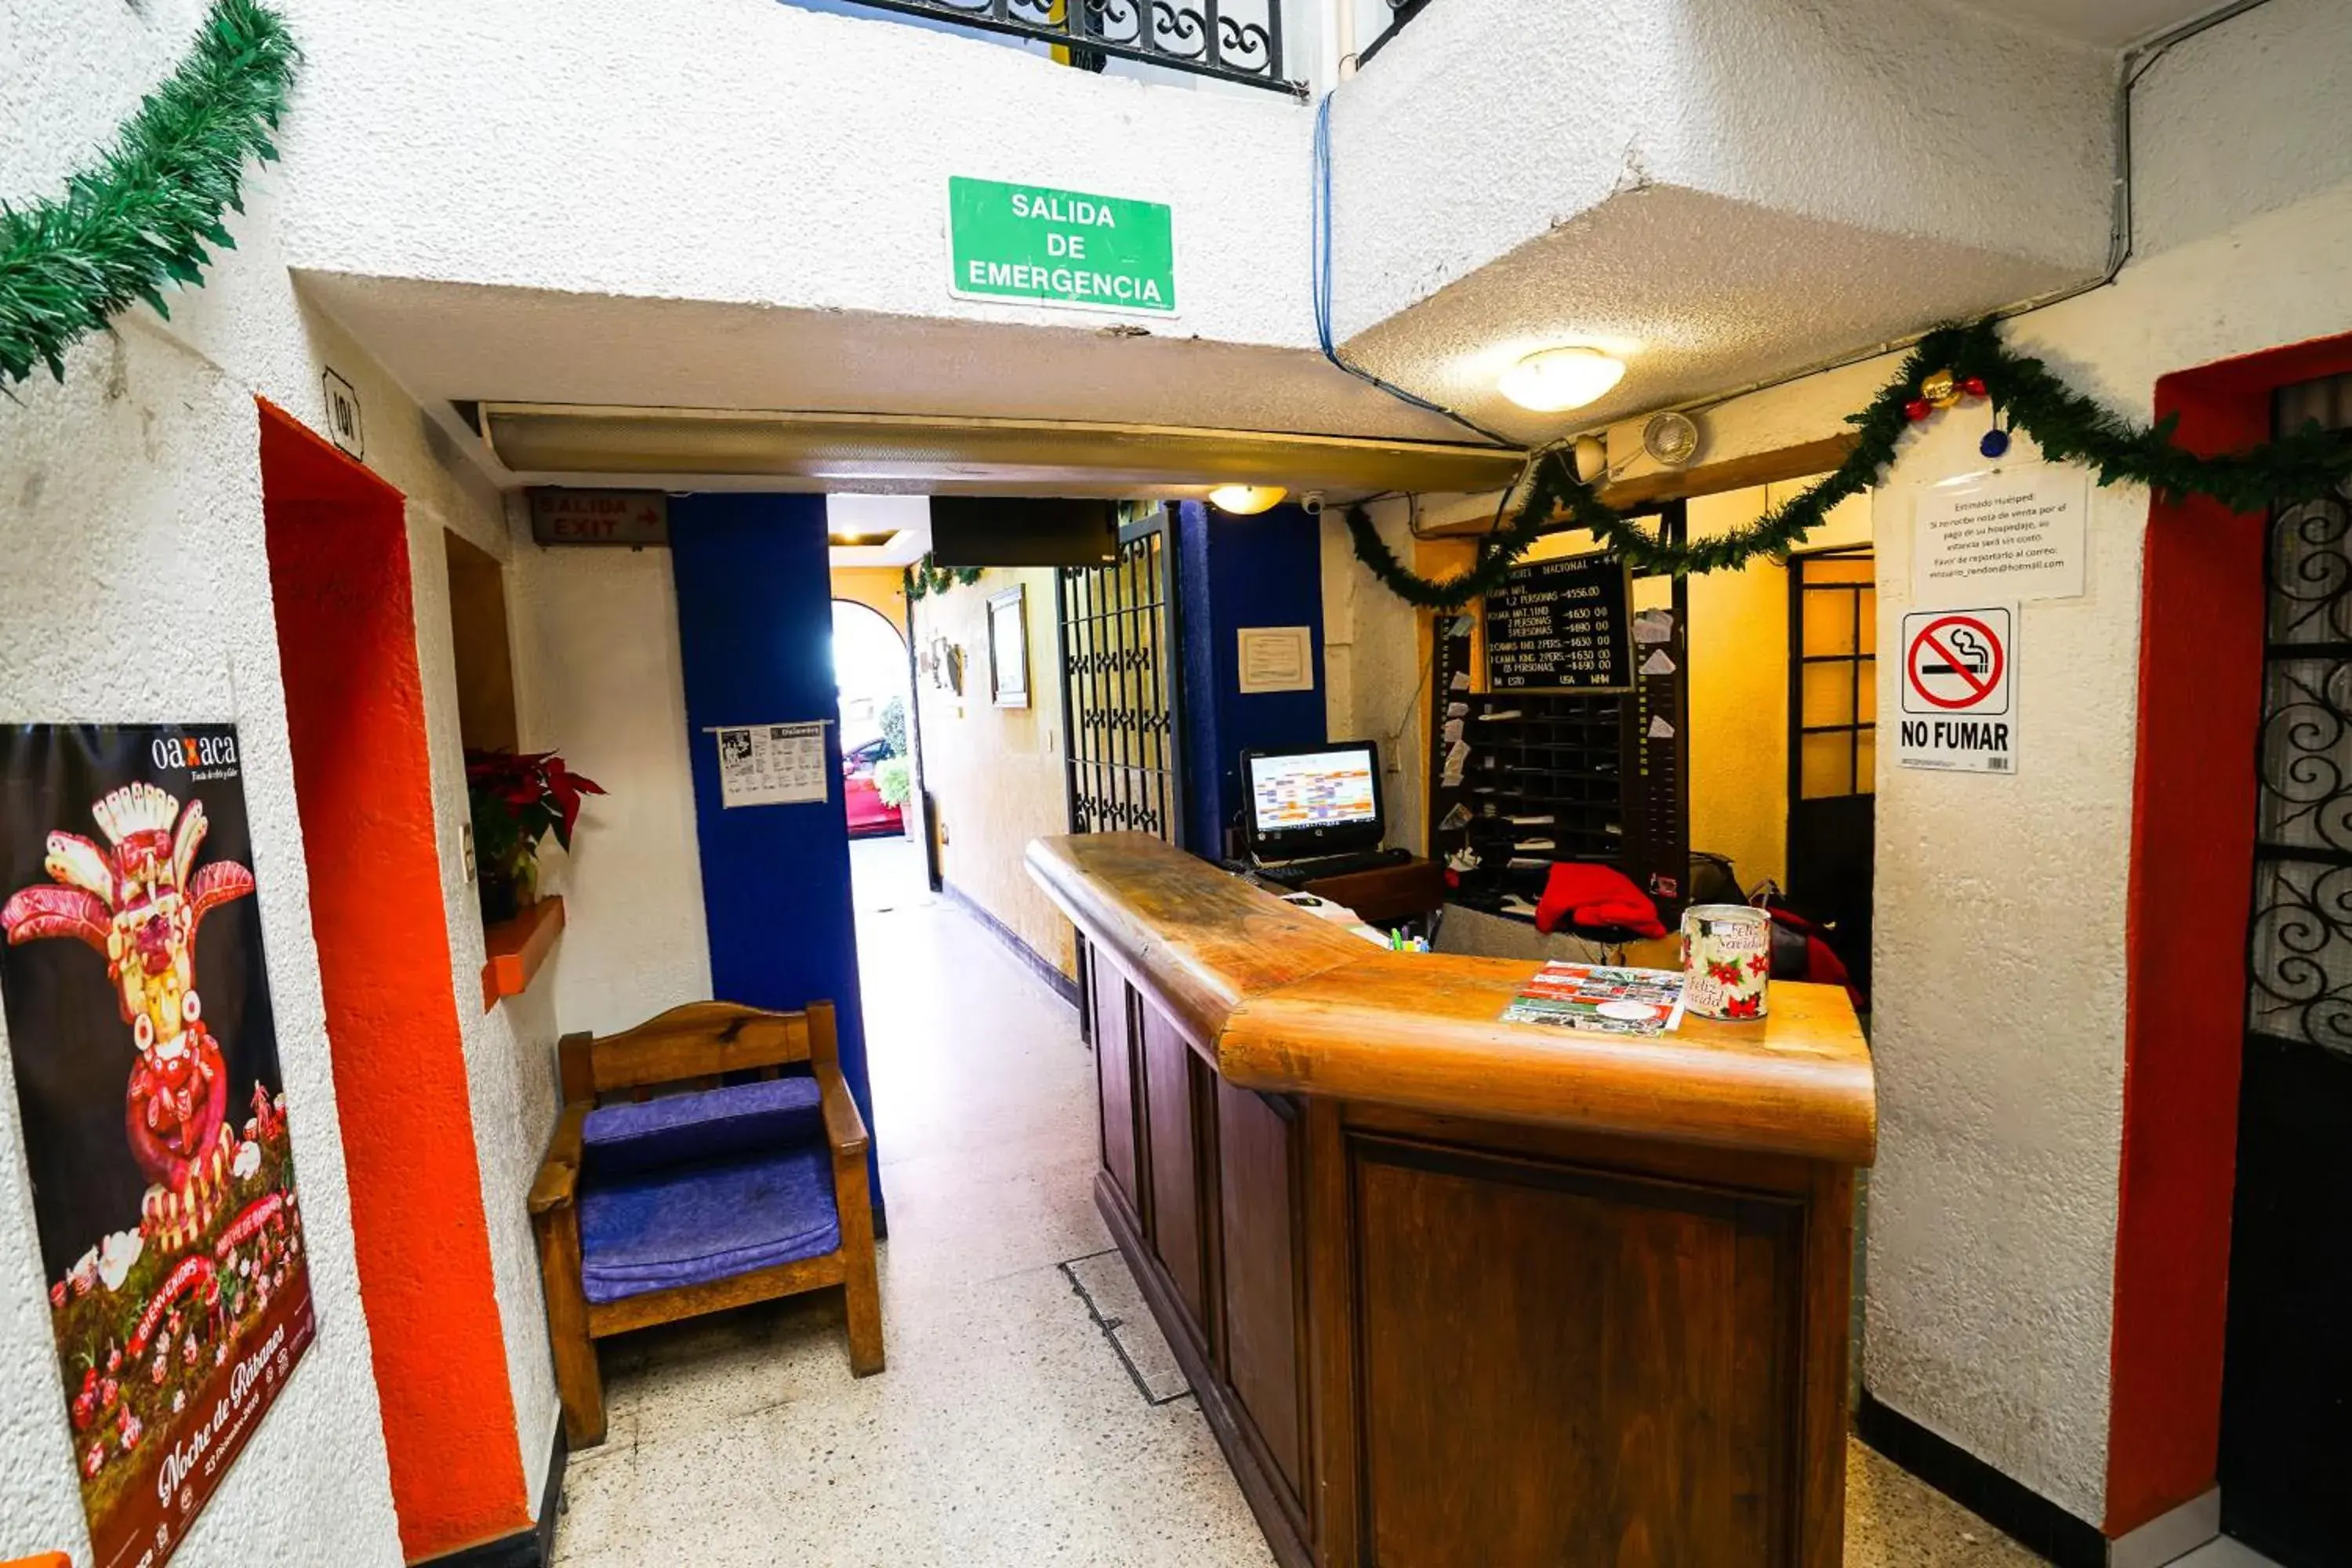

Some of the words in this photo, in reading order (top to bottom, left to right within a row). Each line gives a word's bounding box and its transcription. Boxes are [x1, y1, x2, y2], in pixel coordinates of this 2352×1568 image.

[1011, 194, 1115, 228] SALIDA
[1047, 233, 1086, 260] DE
[969, 260, 1162, 302] EMERGENCIA
[539, 496, 627, 514] SALIDA
[1998, 511, 2009, 520] de
[2012, 508, 2037, 518] venta
[2039, 505, 2056, 516] por
[554, 518, 619, 537] EXIT
[1901, 720, 1928, 747] NO
[1934, 721, 2009, 751] FUMAR
[152, 736, 236, 769] oaxaca
[158, 1440, 211, 1508] Noche
[213, 1398, 229, 1432] de
